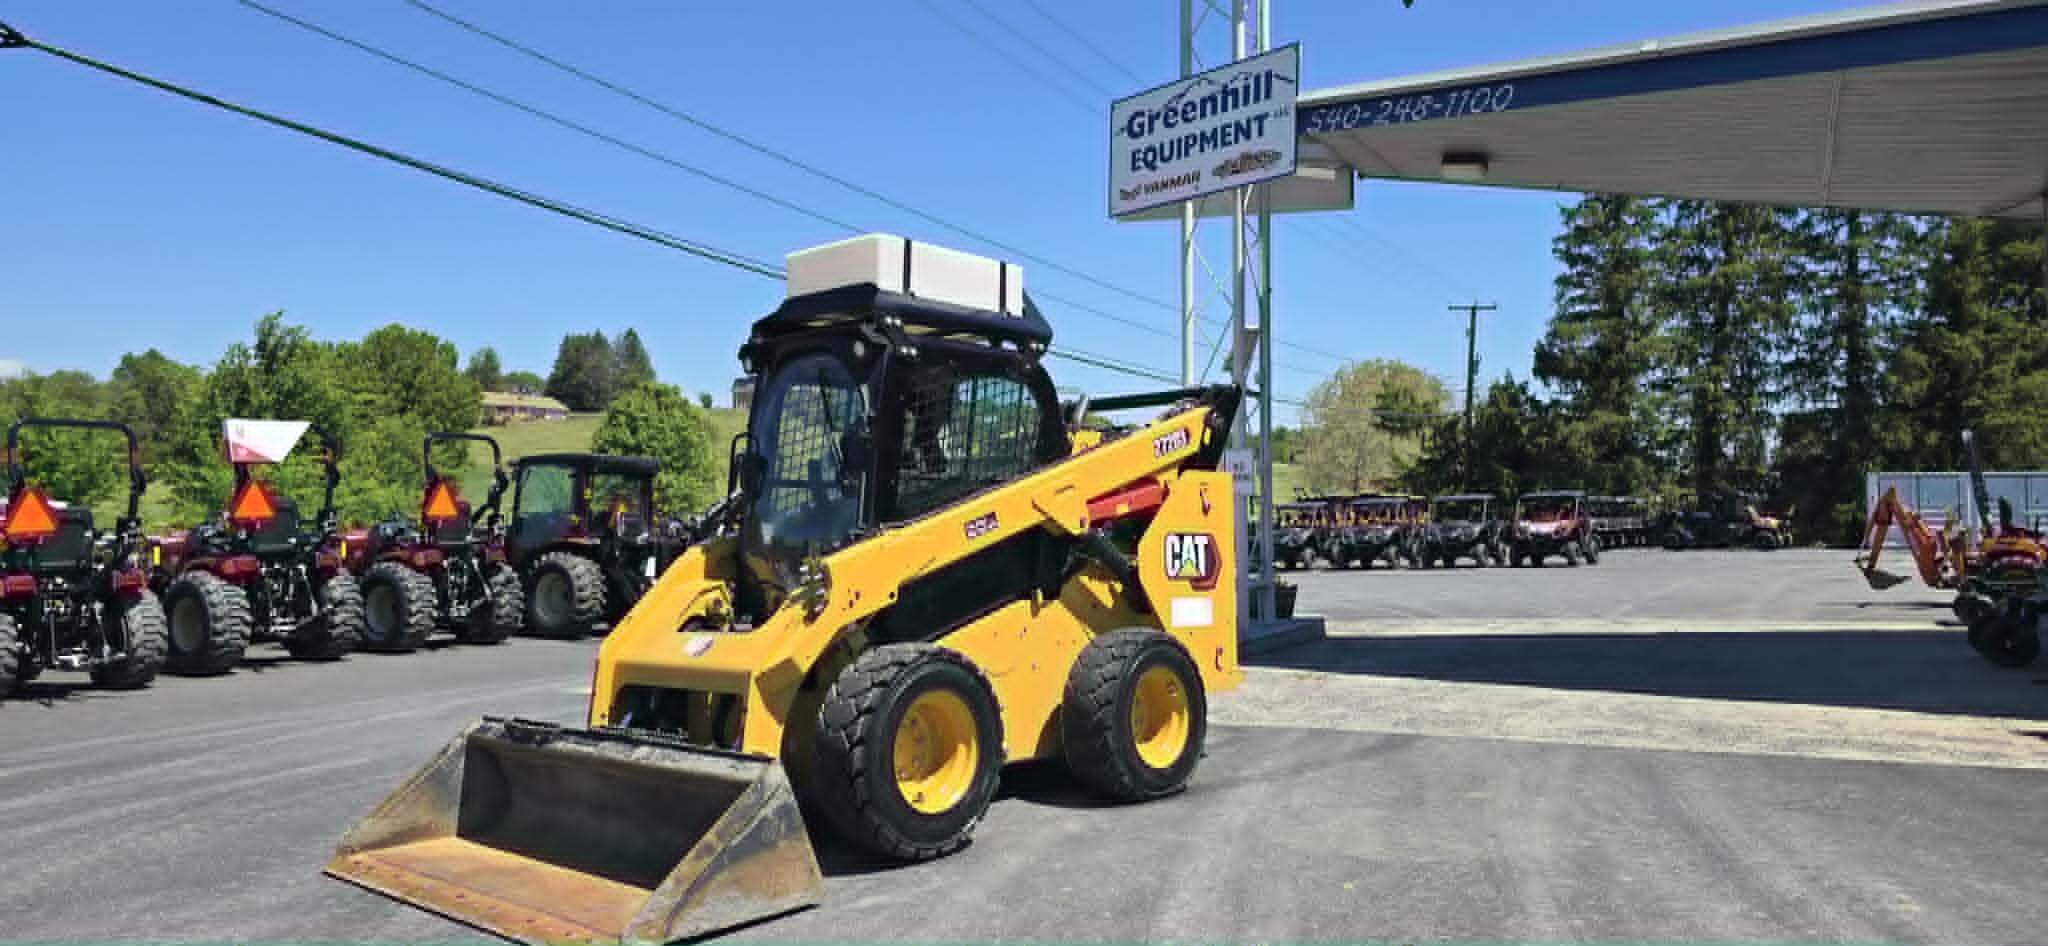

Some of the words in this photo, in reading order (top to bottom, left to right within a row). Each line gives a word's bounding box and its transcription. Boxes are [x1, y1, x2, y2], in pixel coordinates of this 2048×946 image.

[1126, 70, 1273, 139] Greenhill
[1130, 112, 1268, 172] EQUIPMENT
[1165, 535, 1209, 577] CAT
